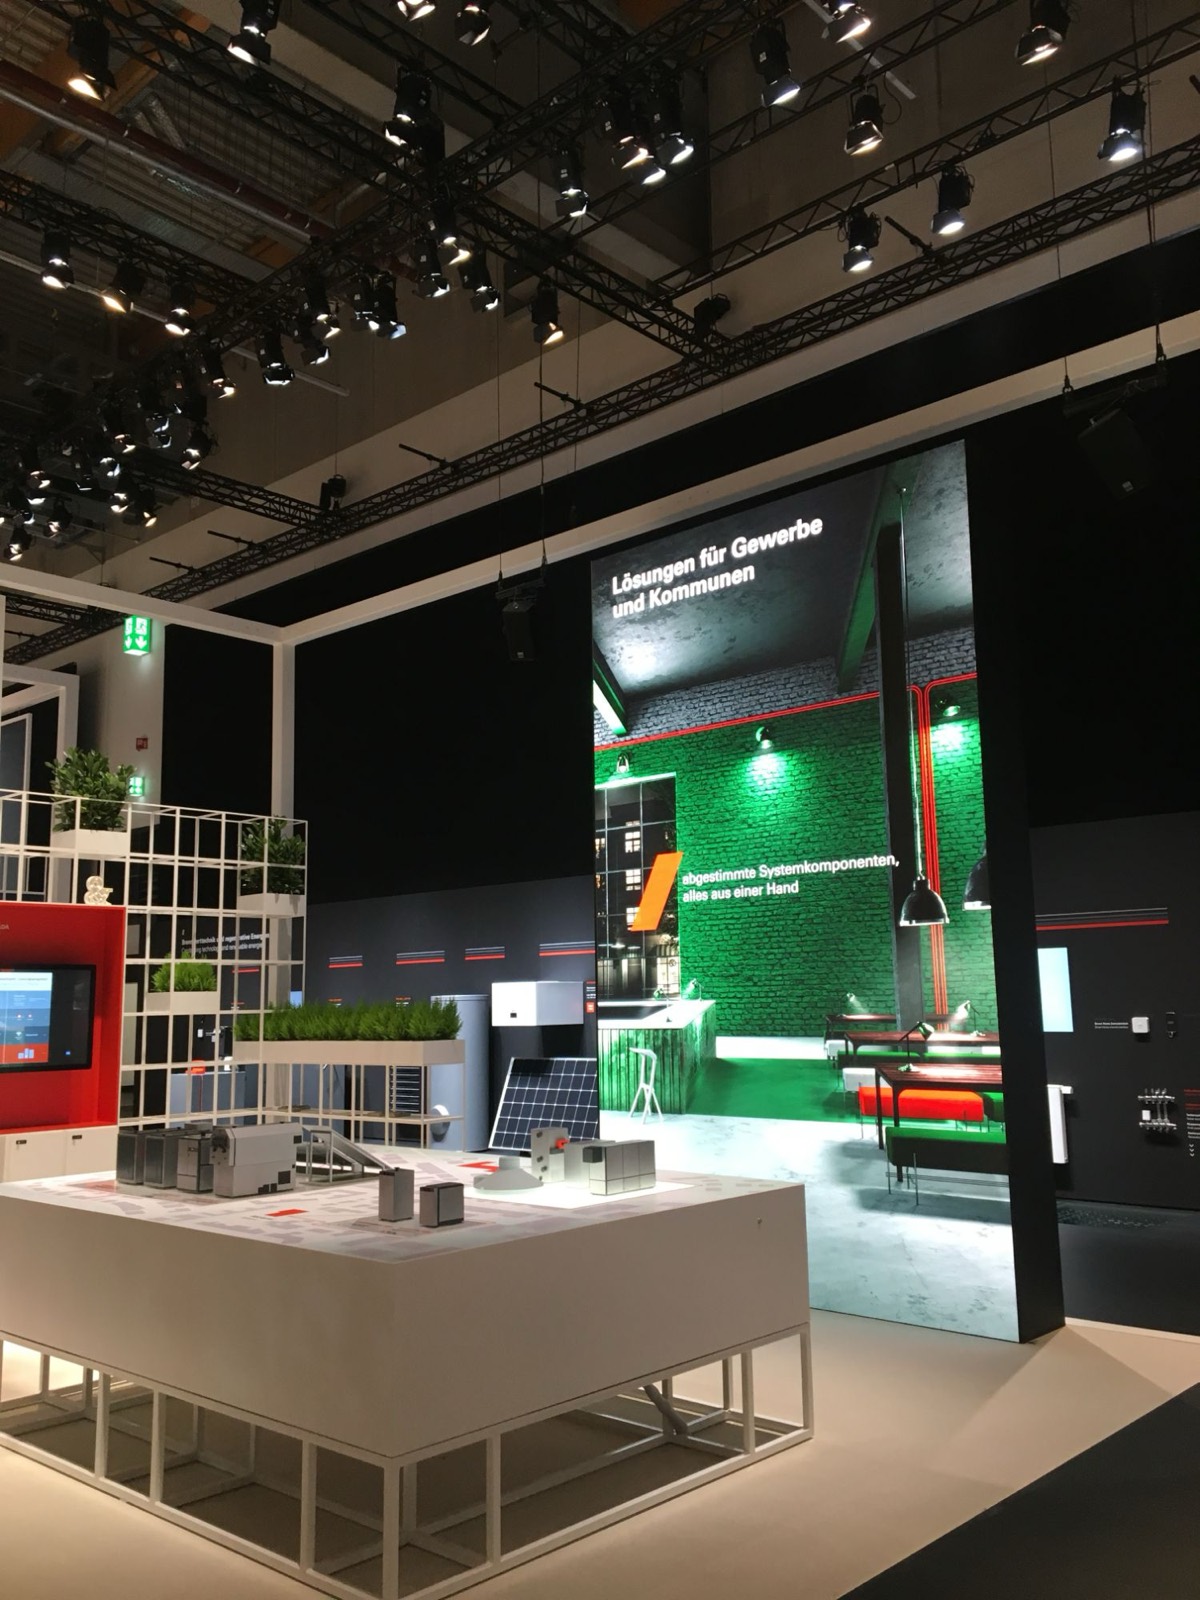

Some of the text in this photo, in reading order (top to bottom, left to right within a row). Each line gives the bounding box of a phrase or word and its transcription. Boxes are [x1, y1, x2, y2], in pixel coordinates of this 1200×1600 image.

[612, 518, 823, 595] Lösungen für Gewerbe
[612, 564, 755, 619] und Kommunen
[682, 854, 900, 886] abgestimmte Systemkomponenten,
[682, 880, 799, 903] alles aus einer Hand
